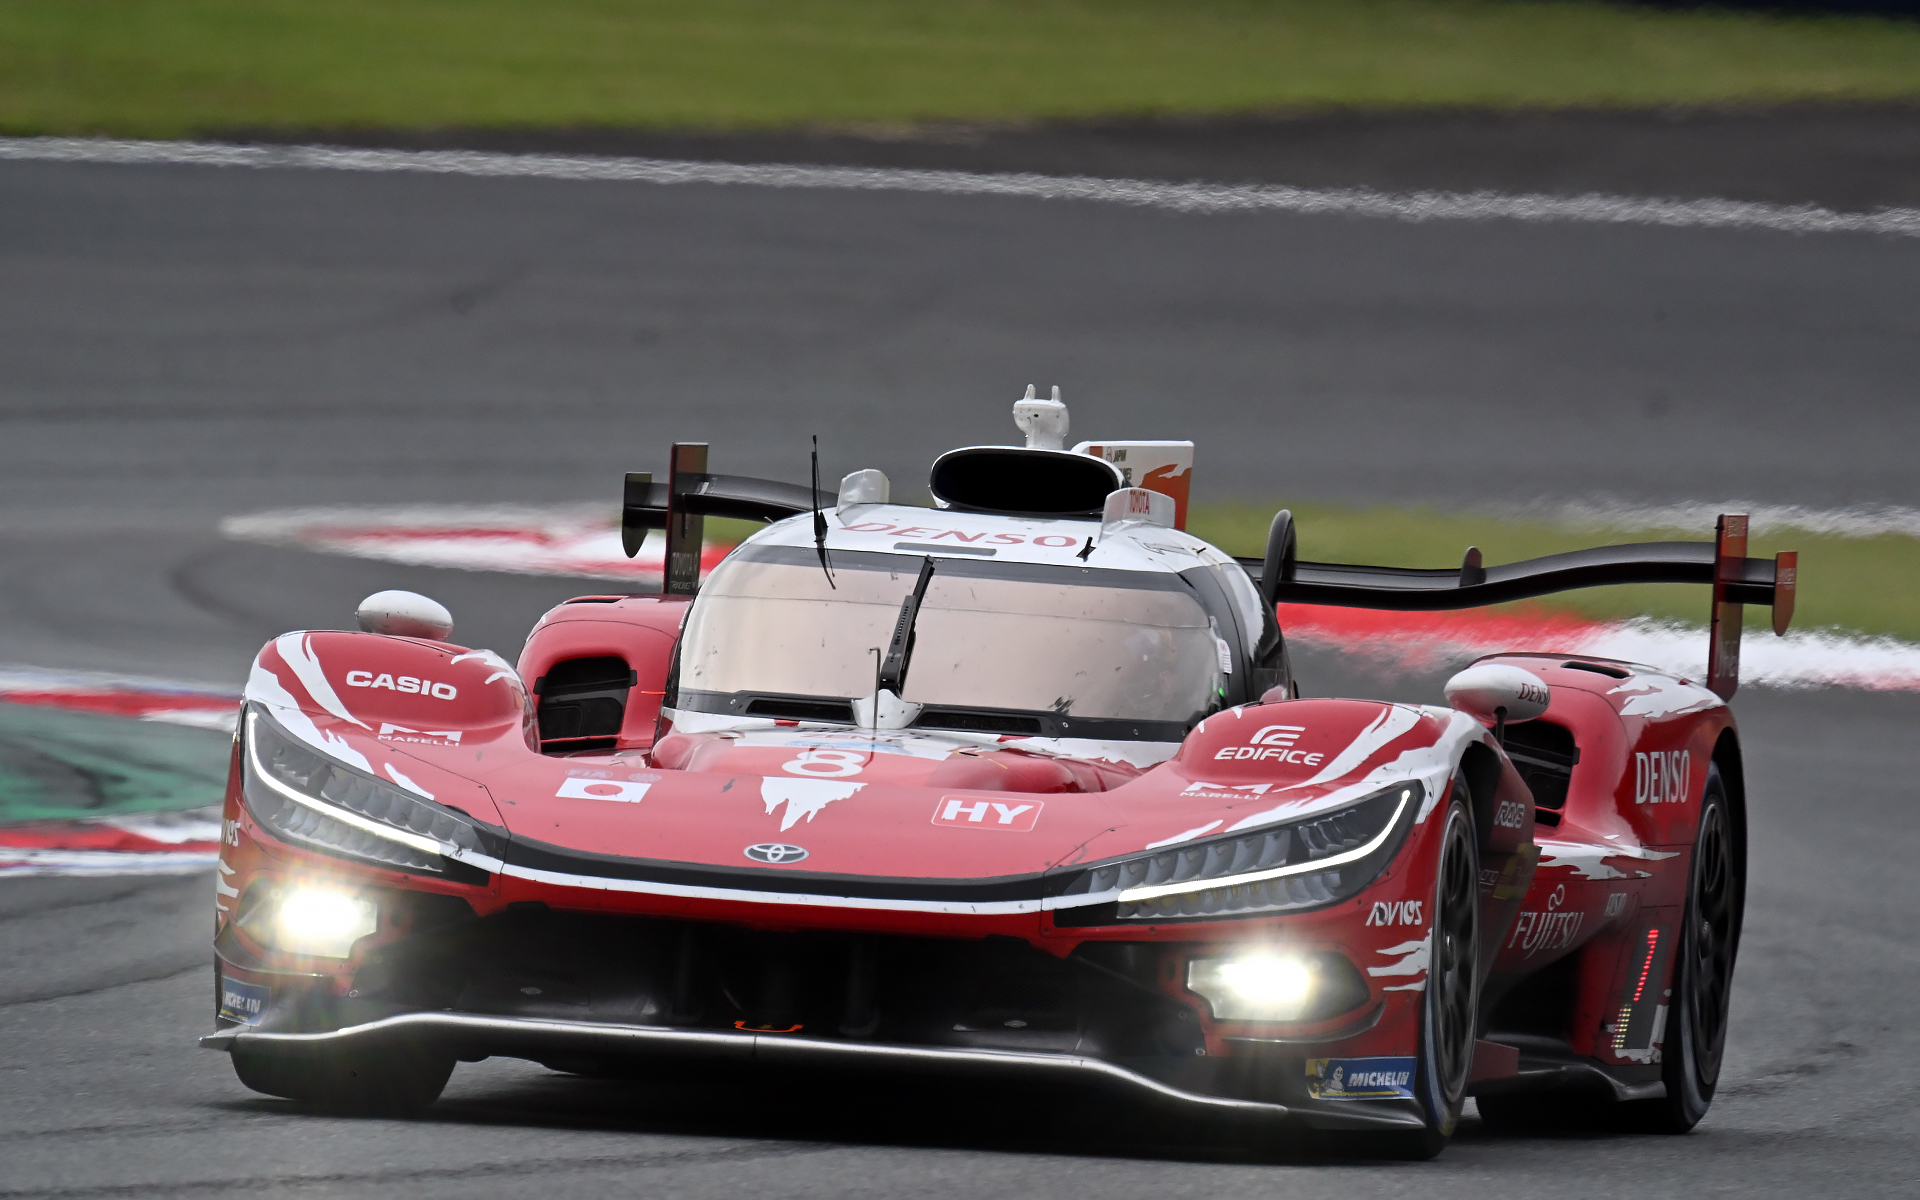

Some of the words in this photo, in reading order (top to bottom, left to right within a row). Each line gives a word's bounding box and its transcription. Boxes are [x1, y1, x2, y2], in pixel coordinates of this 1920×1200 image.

[840, 522, 1077, 548] DENSO
[346, 670, 457, 701] CASIO
[378, 735, 460, 747] MARELLI
[782, 750, 865, 778] 8
[1214, 747, 1324, 767] EDIFICE
[1635, 750, 1691, 805] DENSO
[1180, 792, 1261, 801] MARELLI
[941, 800, 1034, 825] HY
[1507, 912, 1584, 960] FUJITSU
[1348, 1071, 1410, 1087] MICHELIN
